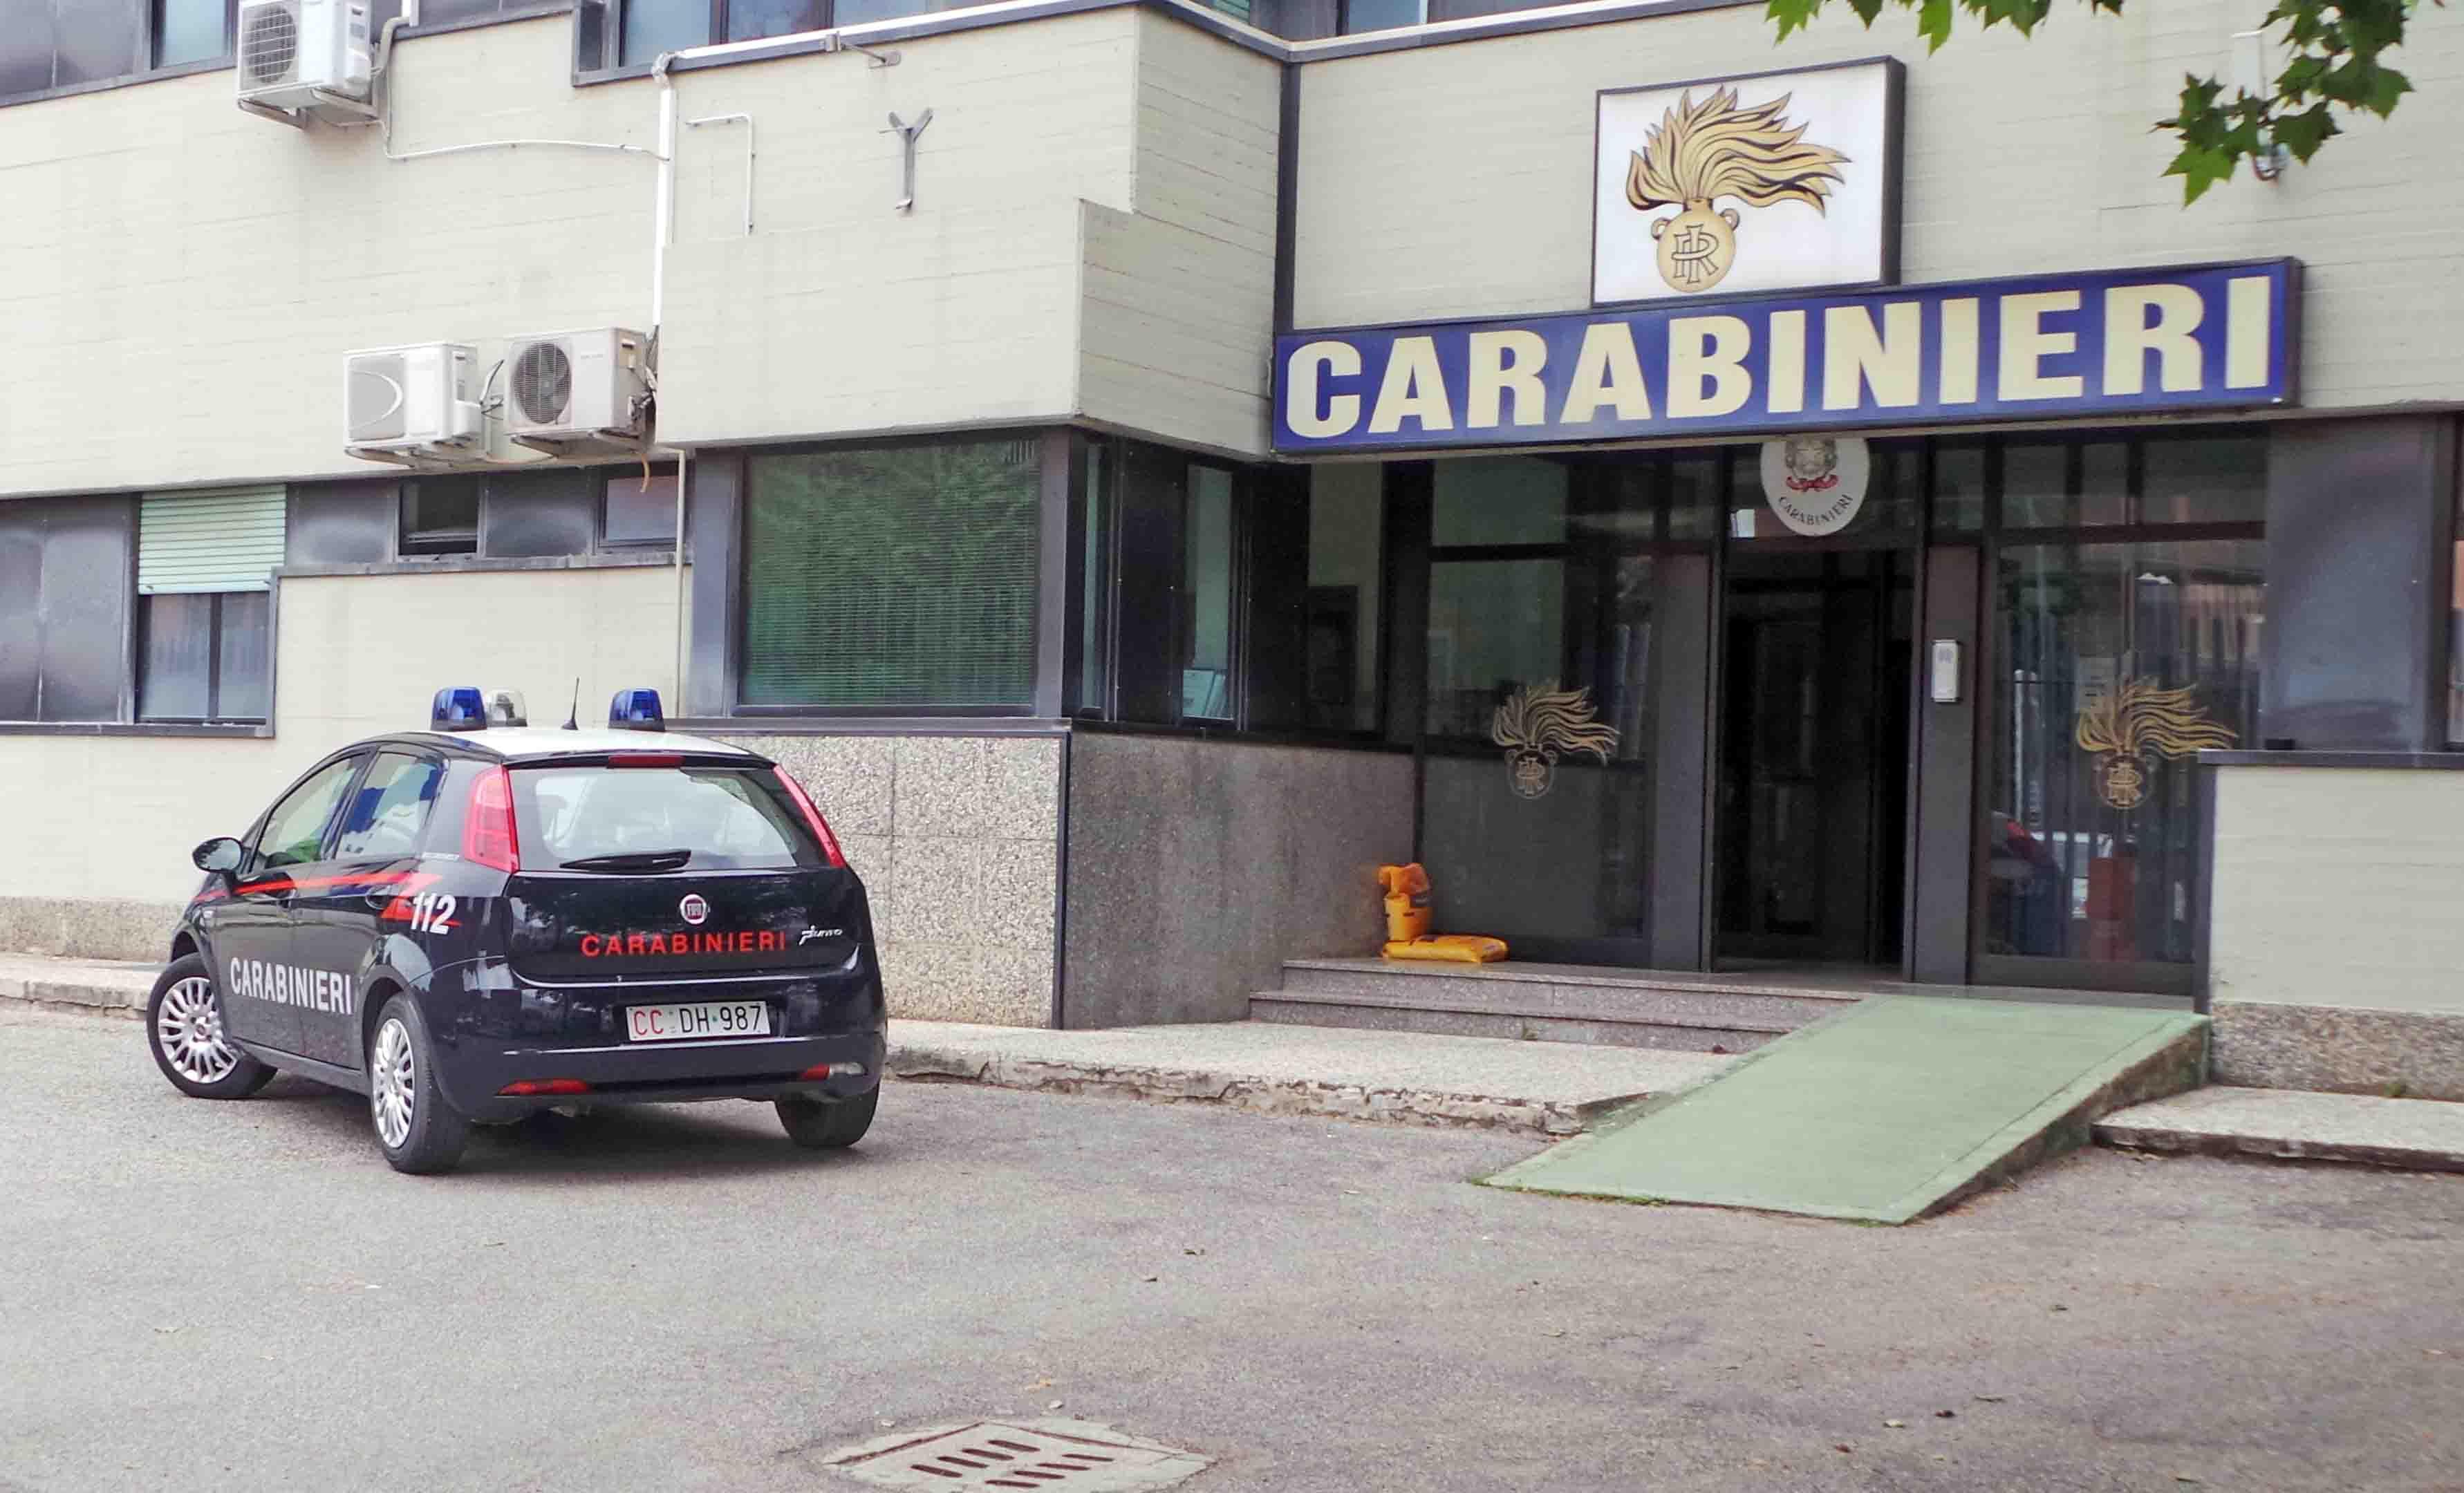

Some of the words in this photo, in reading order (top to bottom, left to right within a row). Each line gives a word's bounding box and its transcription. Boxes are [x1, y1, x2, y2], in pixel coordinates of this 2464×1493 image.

[1285, 275, 2272, 438] CARABINIERI
[1778, 494, 1854, 526] CARABINIERI
[411, 892, 456, 935] 112
[581, 932, 786, 957] CARABINIERI
[230, 957, 353, 1015] CARABINIERI
[633, 1010, 664, 1035] CC
